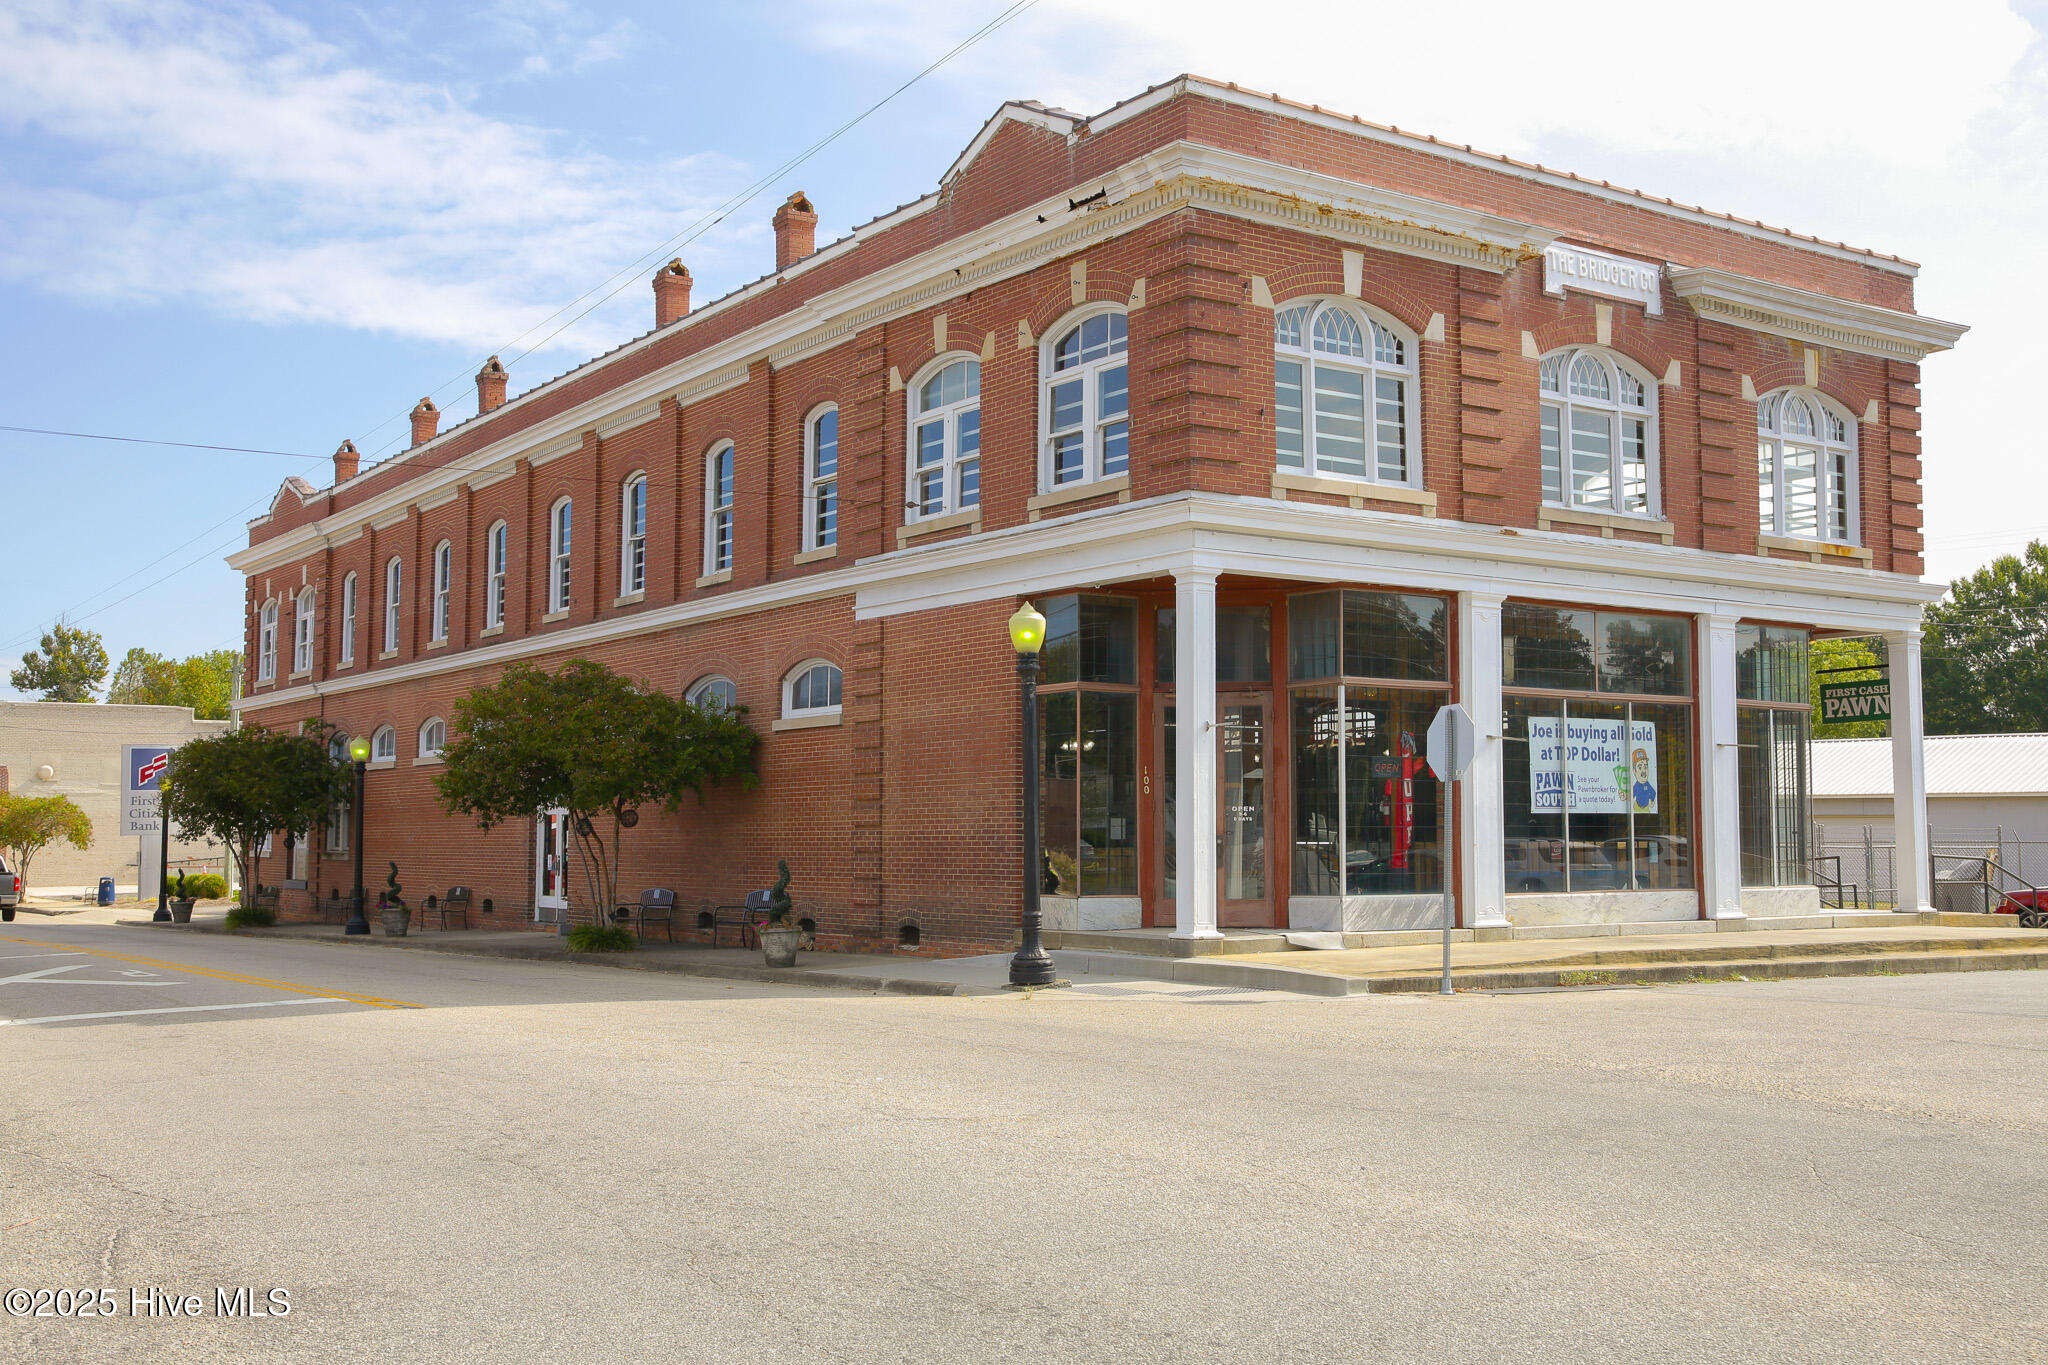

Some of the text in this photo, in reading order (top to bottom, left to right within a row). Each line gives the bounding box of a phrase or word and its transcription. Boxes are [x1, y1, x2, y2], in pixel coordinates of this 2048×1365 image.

[1551, 250, 1655, 293] THE BRIDGER CO
[1825, 685, 1888, 697] FIRST CASH
[1824, 694, 1891, 718] PAWN
[1532, 723, 1552, 738] Joe
[1567, 724, 1607, 743] buying
[1611, 726, 1624, 740] all
[1541, 747, 1552, 760] at
[1582, 747, 1620, 761] Dollar!
[1375, 763, 1399, 773] OPEN
[1536, 772, 1574, 790] PAWN
[131, 796, 156, 805] First
[1583, 796, 1597, 804] quote
[1599, 795, 1616, 804] today!
[130, 821, 160, 830] Bank
